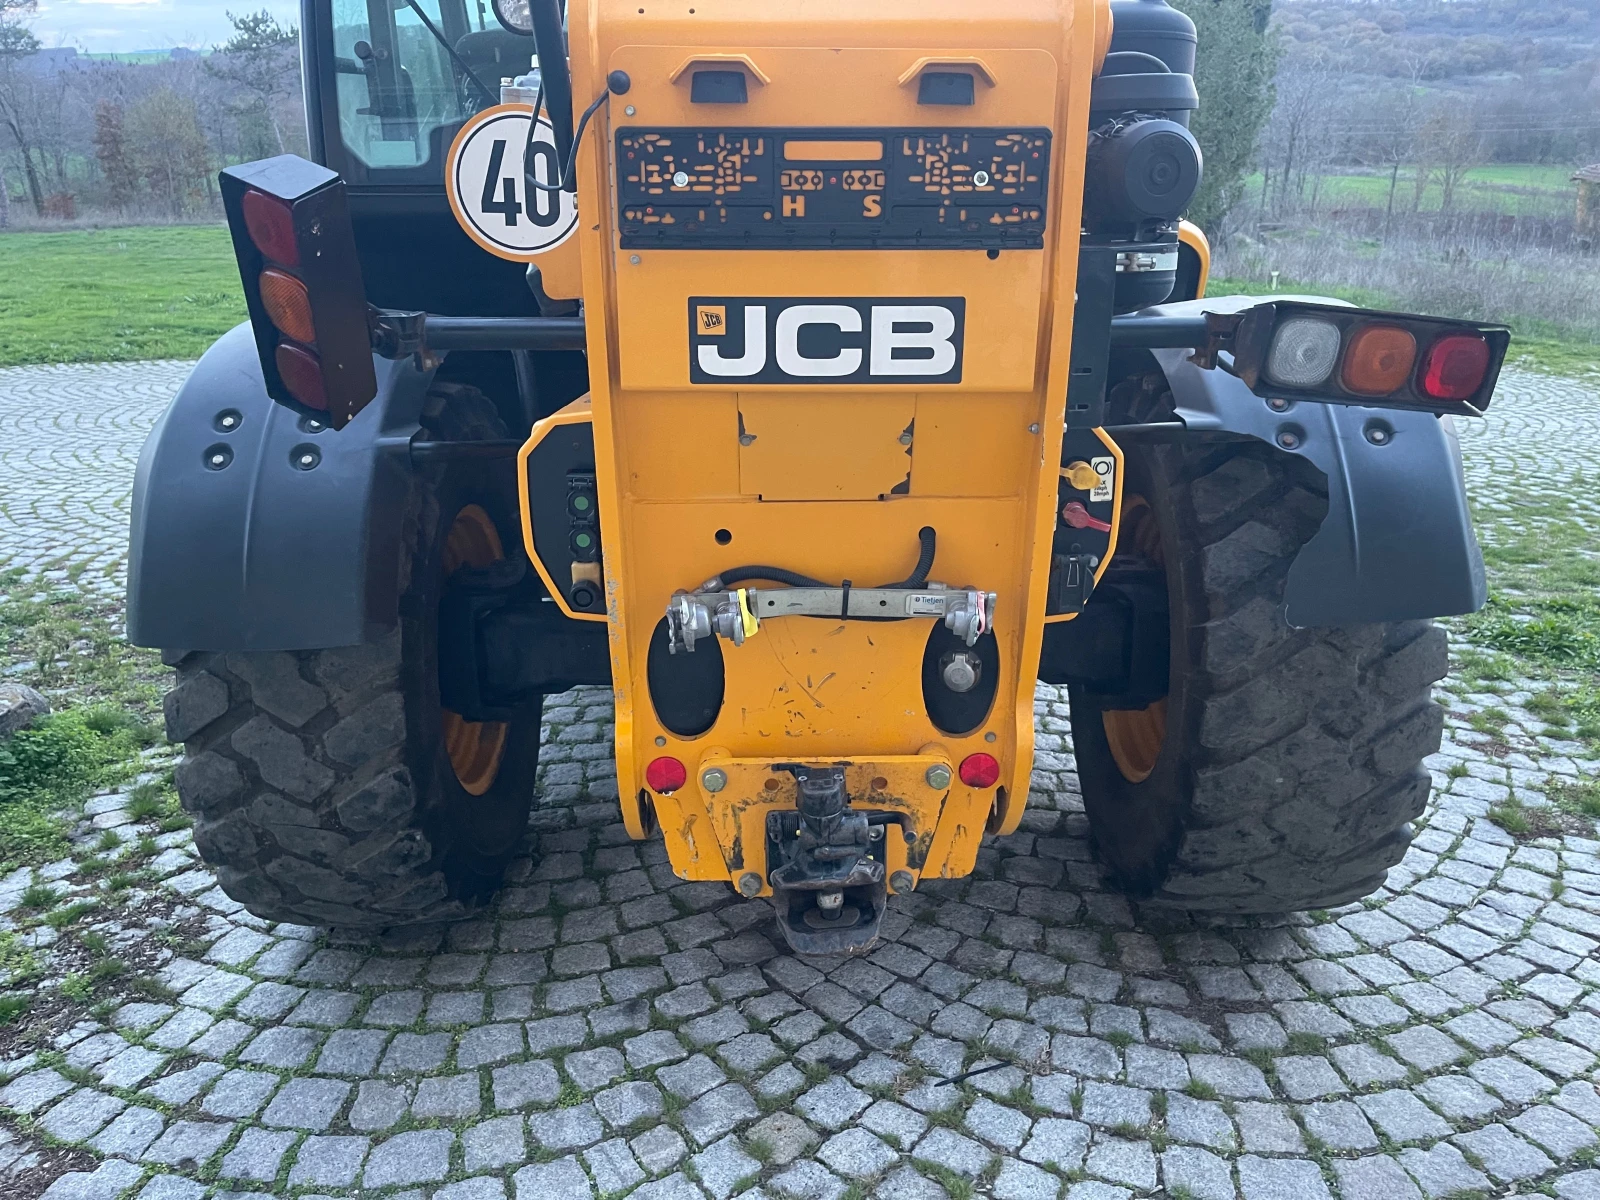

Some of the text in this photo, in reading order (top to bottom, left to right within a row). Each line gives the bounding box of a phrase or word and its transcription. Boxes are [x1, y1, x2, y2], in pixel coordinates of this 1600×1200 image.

[481, 139, 561, 227] 40
[782, 194, 882, 218] H S
[697, 304, 956, 377] JCB
[704, 313, 721, 327] JCB
